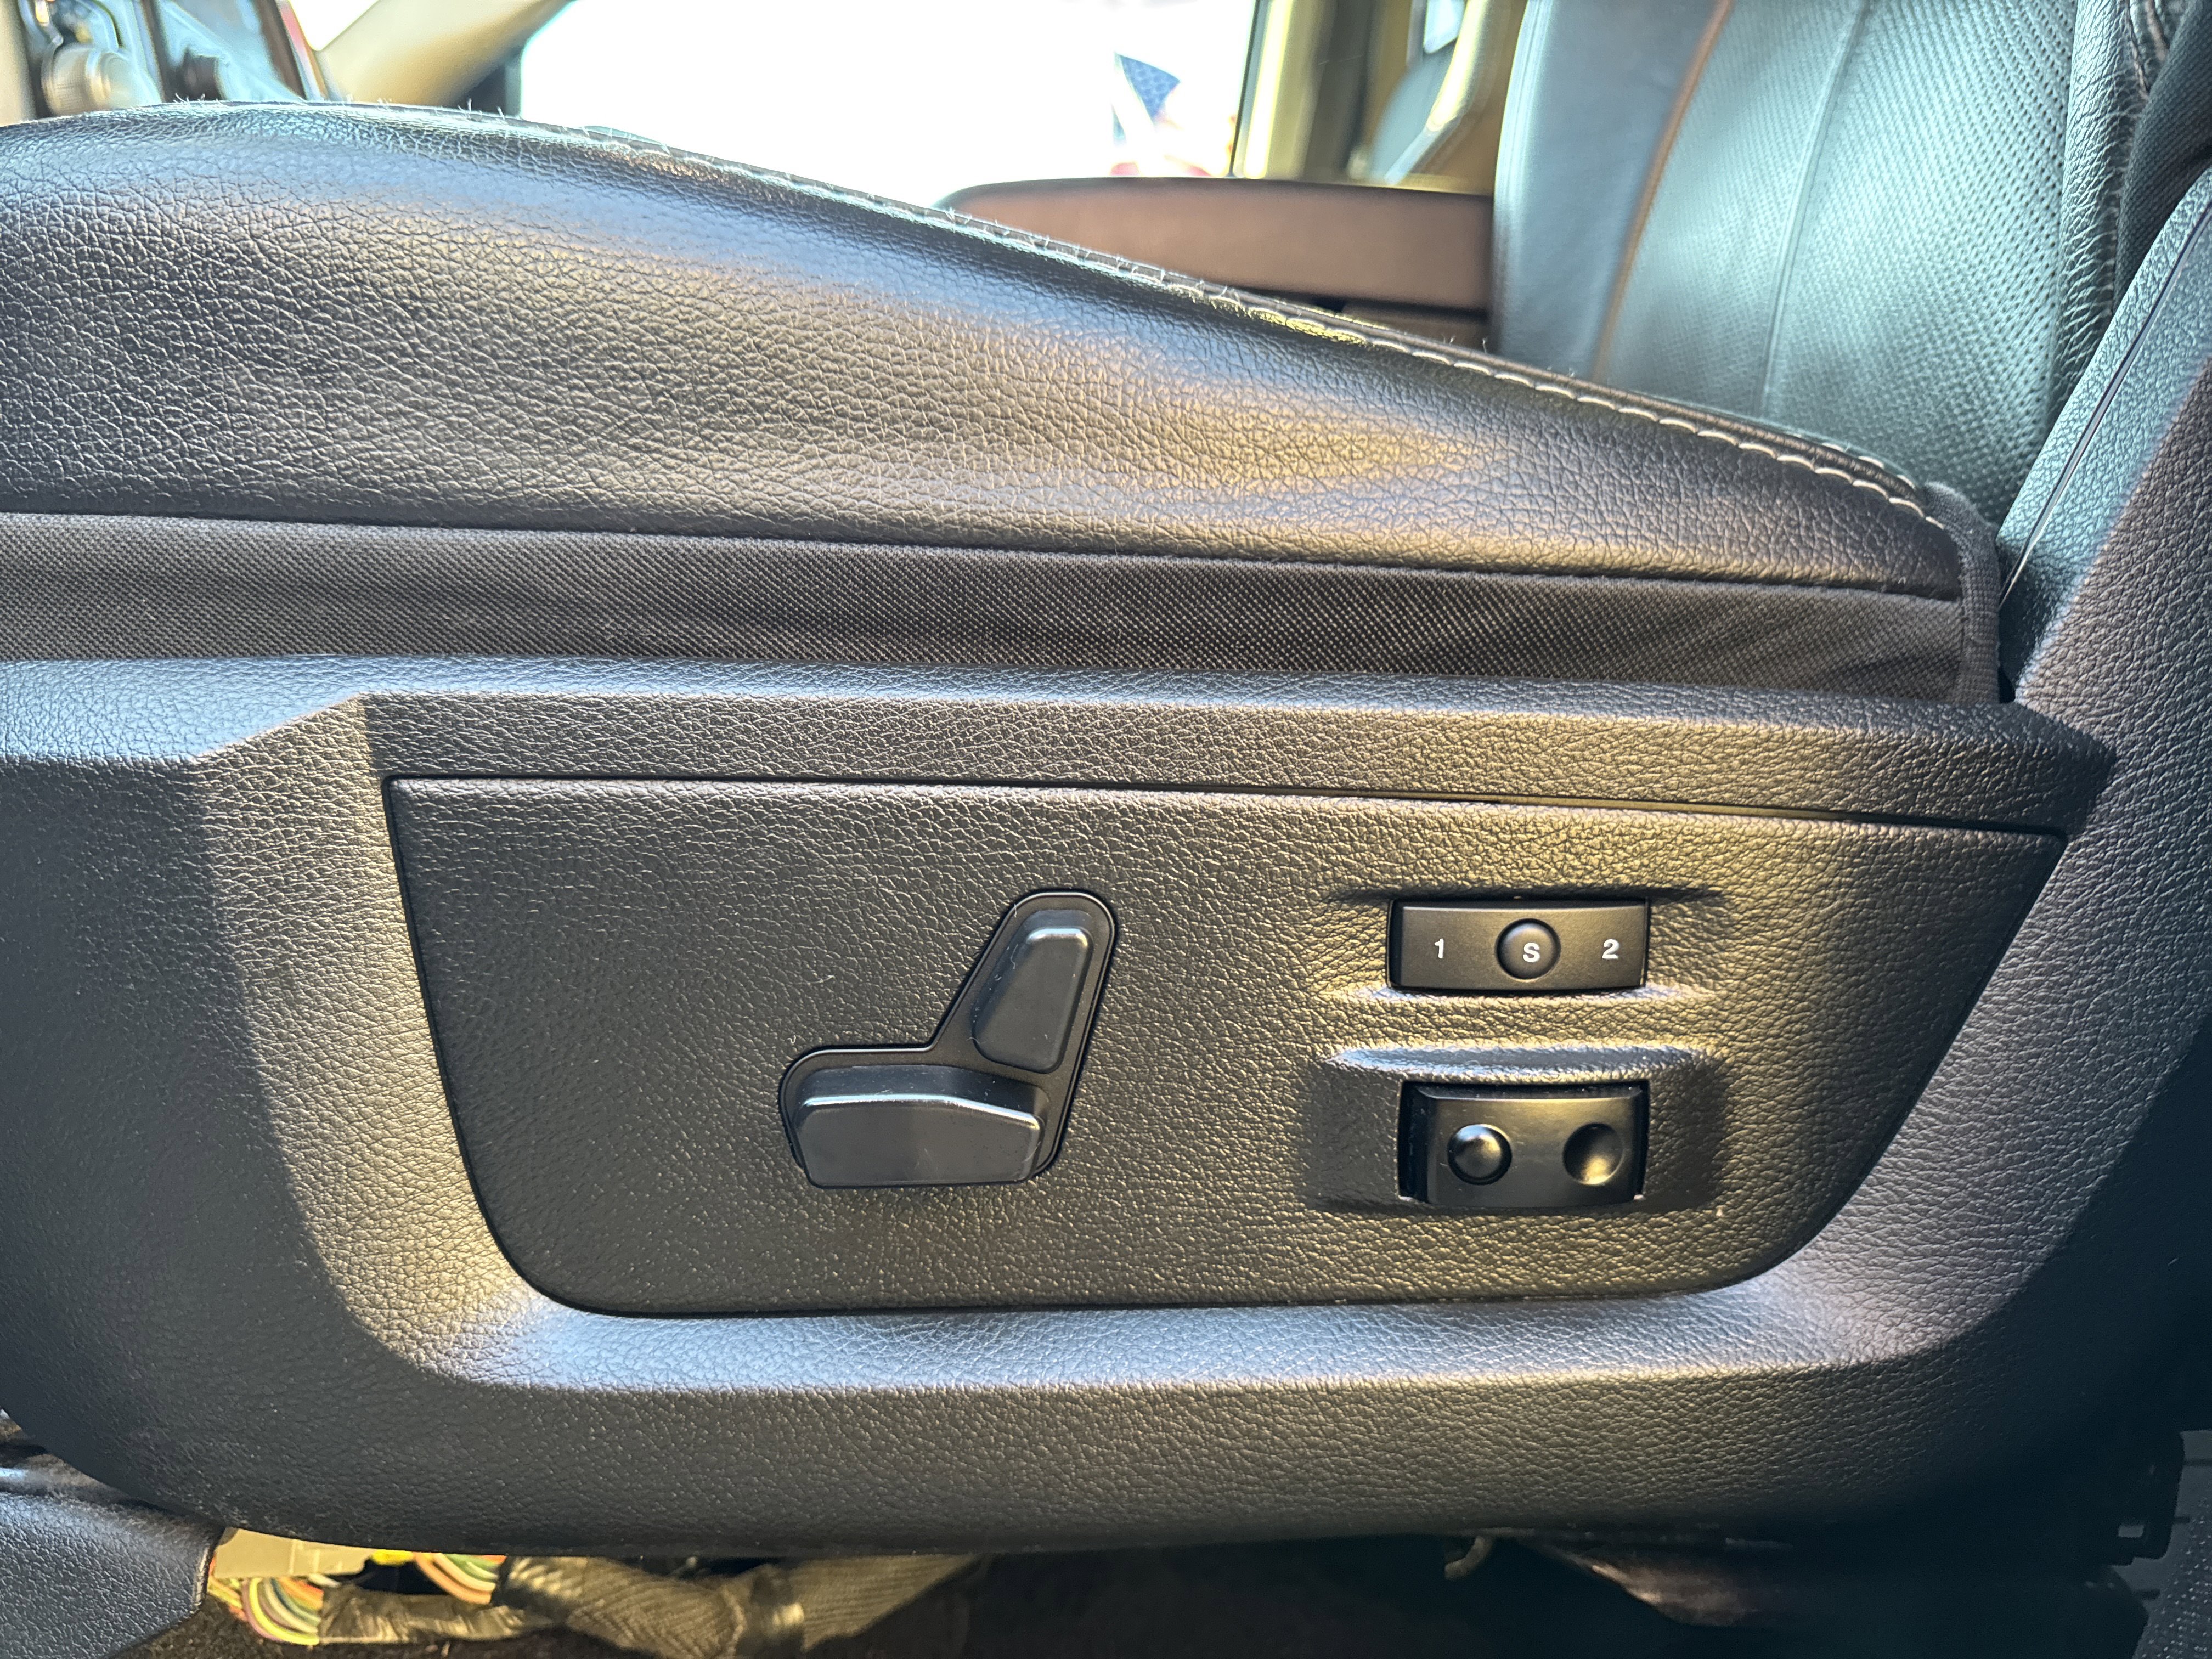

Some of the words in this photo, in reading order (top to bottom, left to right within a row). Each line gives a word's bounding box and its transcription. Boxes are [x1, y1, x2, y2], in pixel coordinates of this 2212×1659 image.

[1434, 938, 1445, 959] 1
[1522, 941, 1541, 963] S
[1601, 939, 1620, 960] 2
